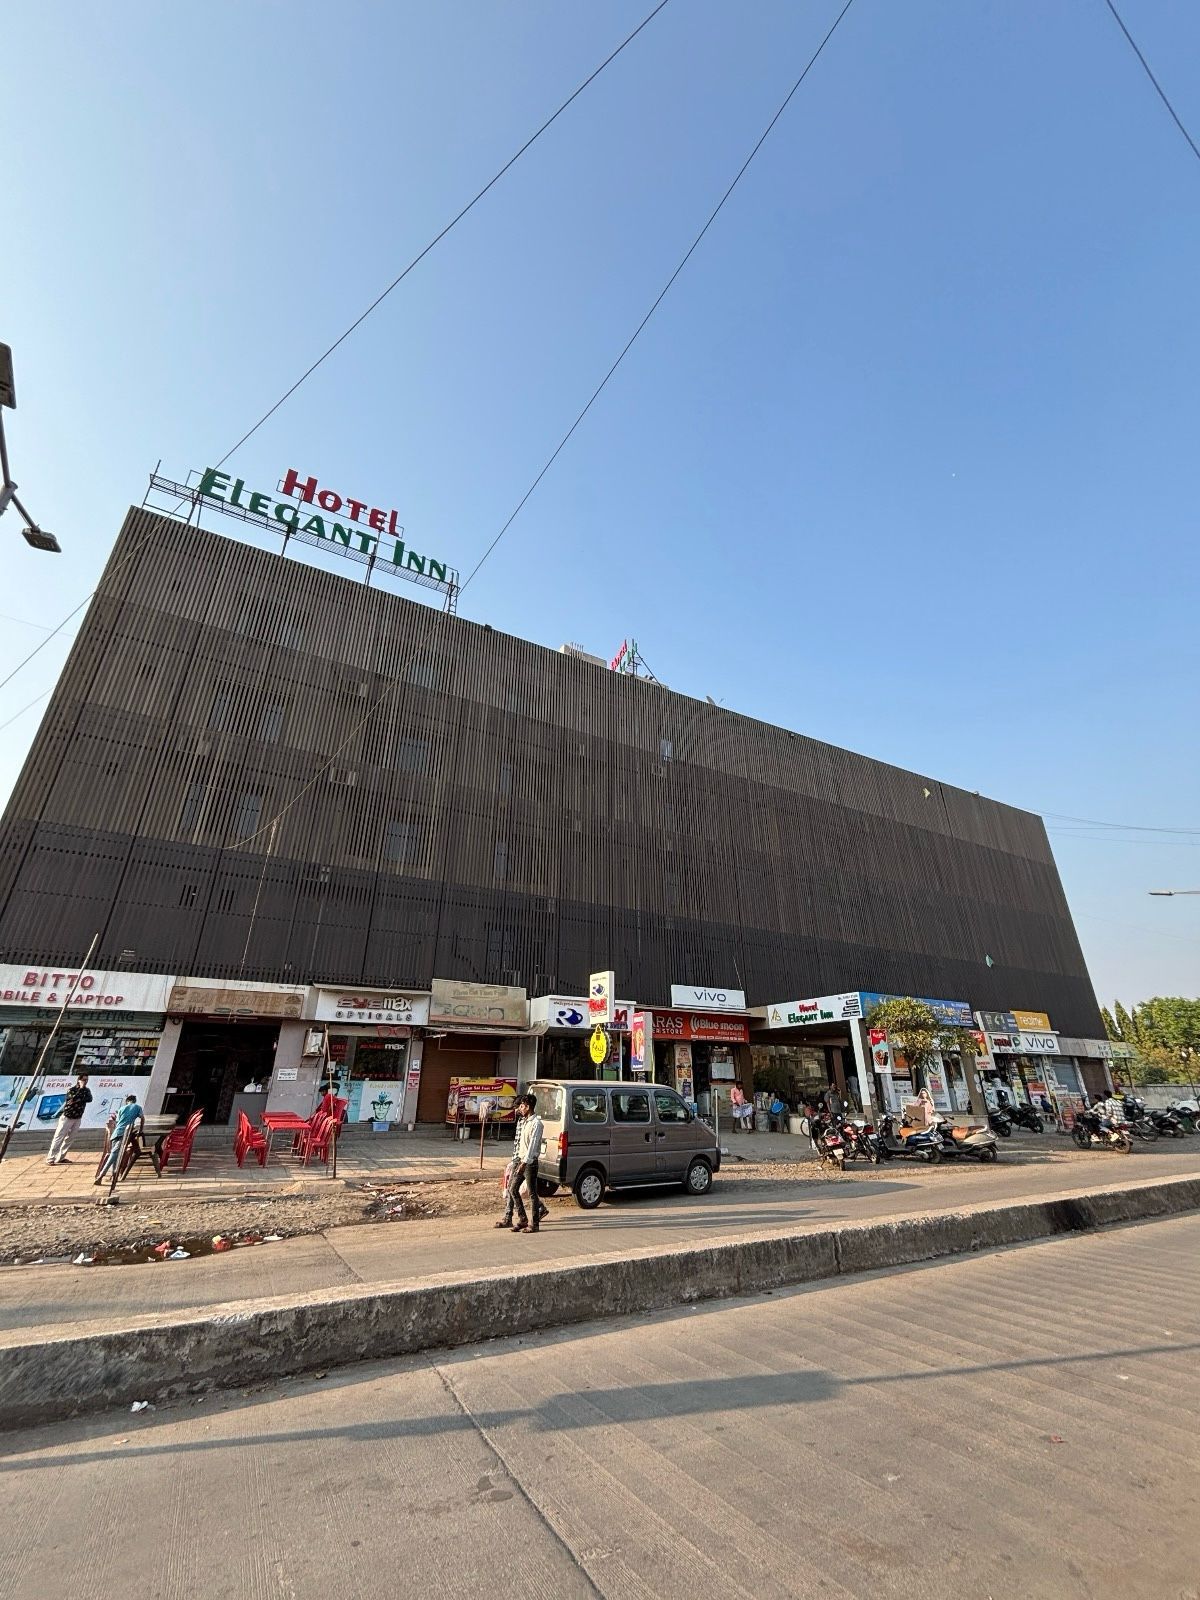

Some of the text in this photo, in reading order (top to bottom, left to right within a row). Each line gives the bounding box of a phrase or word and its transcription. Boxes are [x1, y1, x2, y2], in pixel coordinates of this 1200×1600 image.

[282, 468, 400, 537] HOTEL
[200, 466, 448, 582] ELEGANT INN
[23, 972, 95, 990] BITTO
[0, 990, 124, 1005] BILE & LAPTOP
[694, 989, 727, 1003] vivo
[335, 1010, 413, 1021] OPTICALS
[652, 1016, 684, 1029] RAS
[700, 1018, 745, 1031] Blue moon
[1025, 1034, 1055, 1049] vivo
